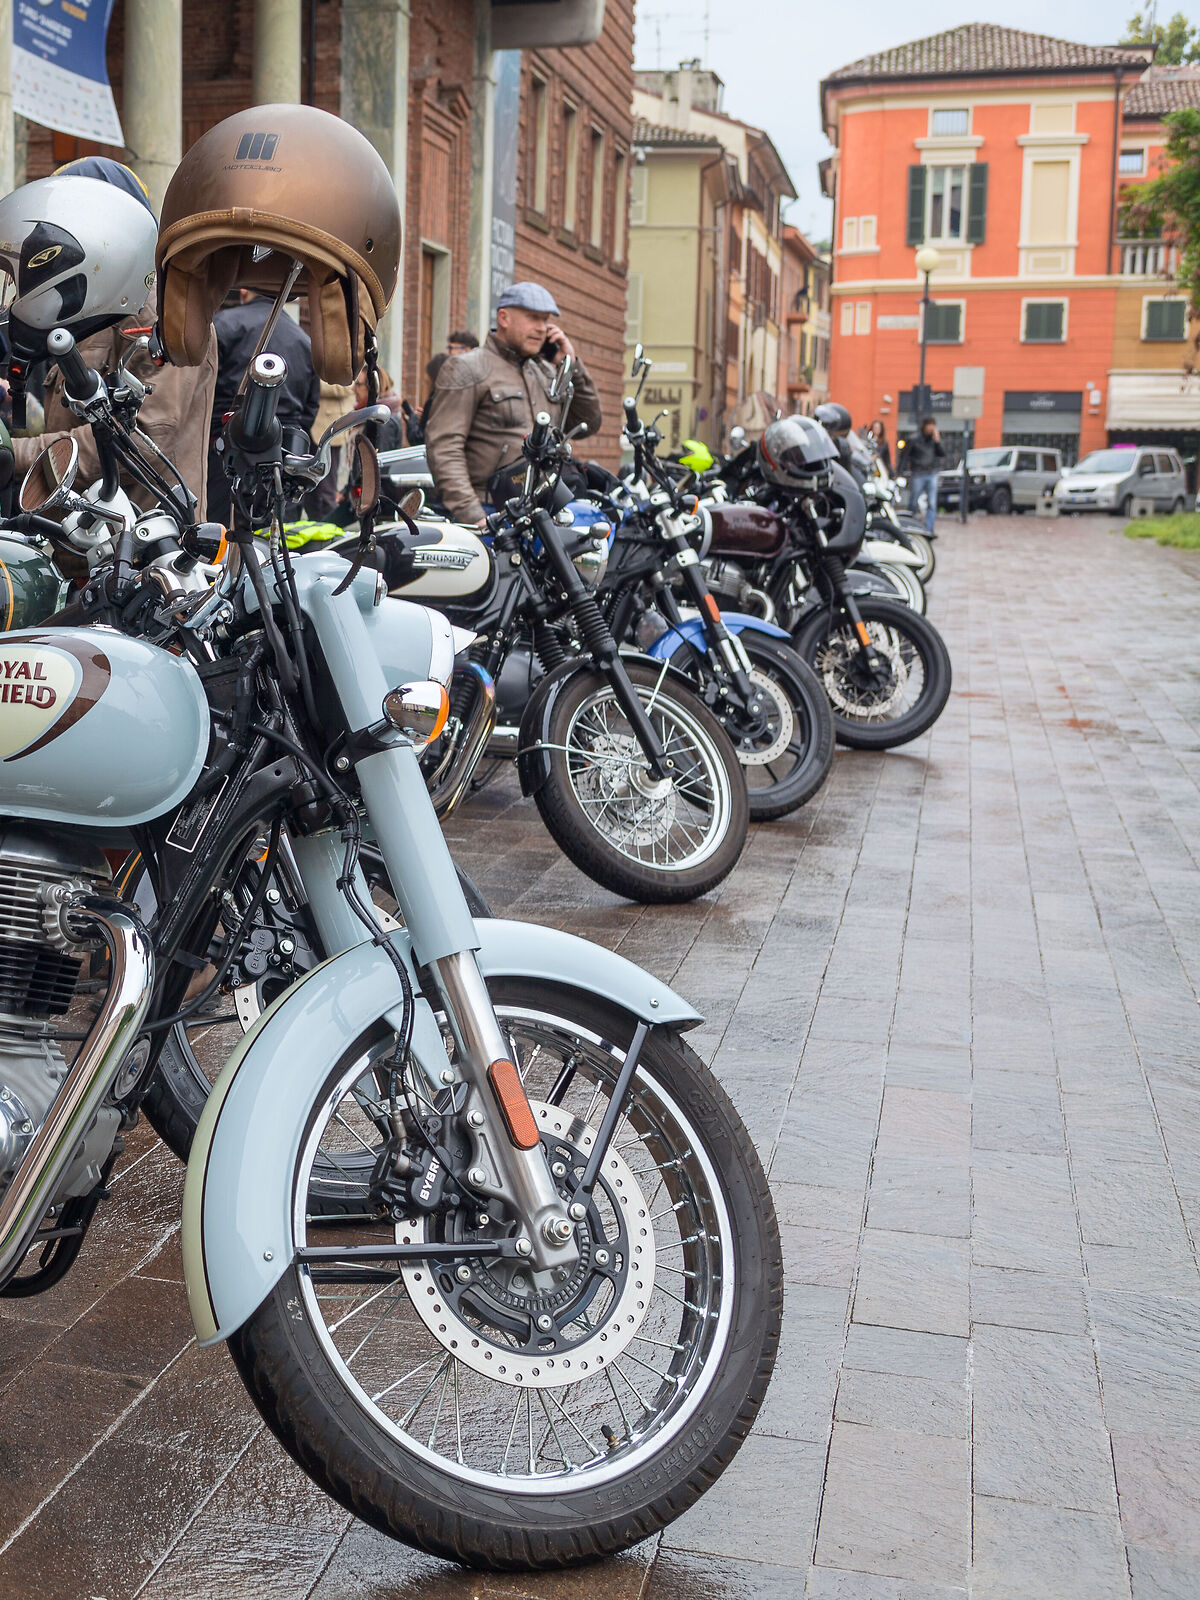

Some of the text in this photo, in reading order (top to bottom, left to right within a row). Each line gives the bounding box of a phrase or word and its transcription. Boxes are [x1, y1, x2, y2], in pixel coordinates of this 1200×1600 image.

[643, 387, 682, 405] ZILLI
[422, 552, 466, 564] TRIUMPH
[687, 1088, 728, 1140] CEAT
